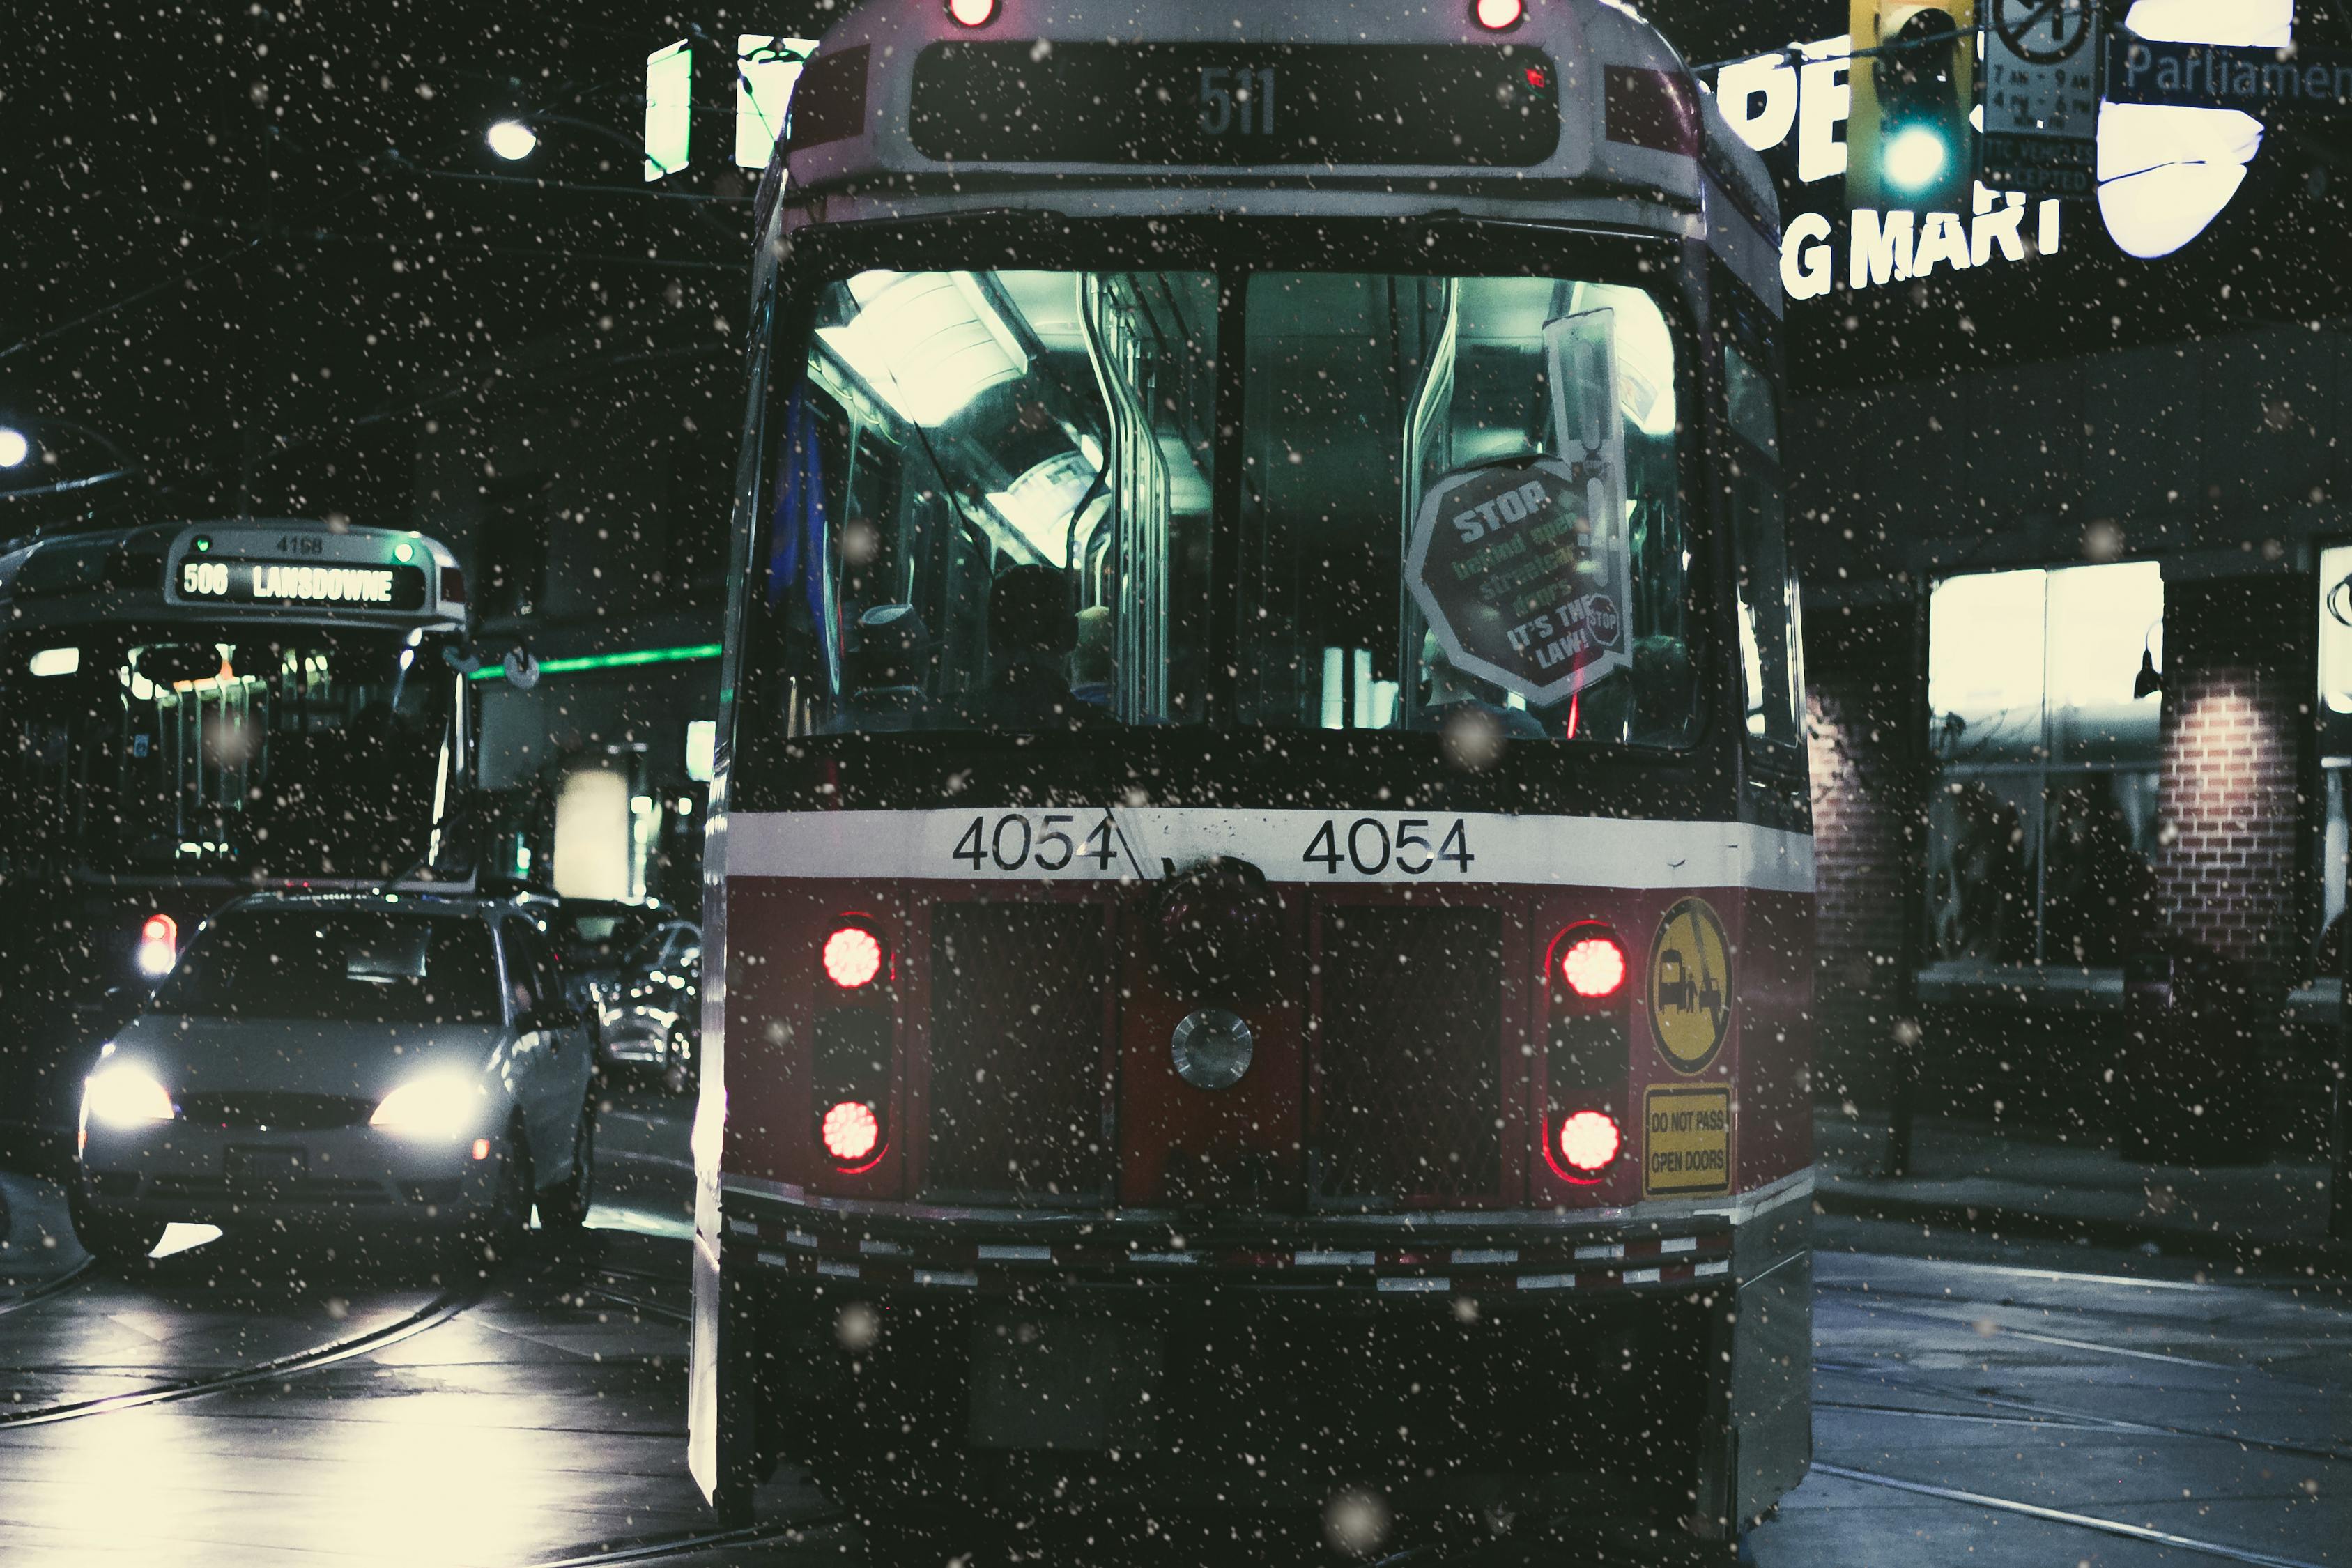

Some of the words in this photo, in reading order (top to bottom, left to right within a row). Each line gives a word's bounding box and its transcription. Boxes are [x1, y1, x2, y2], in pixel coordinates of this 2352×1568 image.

[1994, 64, 2004, 84] 7
[2056, 68, 2066, 88] 9
[2071, 75, 2090, 90] AM
[1200, 67, 1275, 134] 511
[1993, 90, 2004, 109] 4
[1985, 138, 2013, 158] TTC
[2019, 141, 2096, 164] VEHICLES
[1452, 480, 1547, 544] STOP
[253, 566, 393, 601] LANSDOWNE
[1507, 615, 1553, 651] IT'S
[1556, 594, 1594, 627] THE
[1589, 609, 1617, 629] STOP
[1535, 629, 1590, 669] LAW!
[953, 814, 1117, 872] 4054
[1302, 817, 1475, 875] 4054
[1652, 1112, 1667, 1133] DO
[1670, 1112, 1693, 1132] NOT
[1696, 1109, 1724, 1132] PASS
[1652, 1151, 1682, 1173] OPEN
[1685, 1148, 1724, 1171] DOORS
